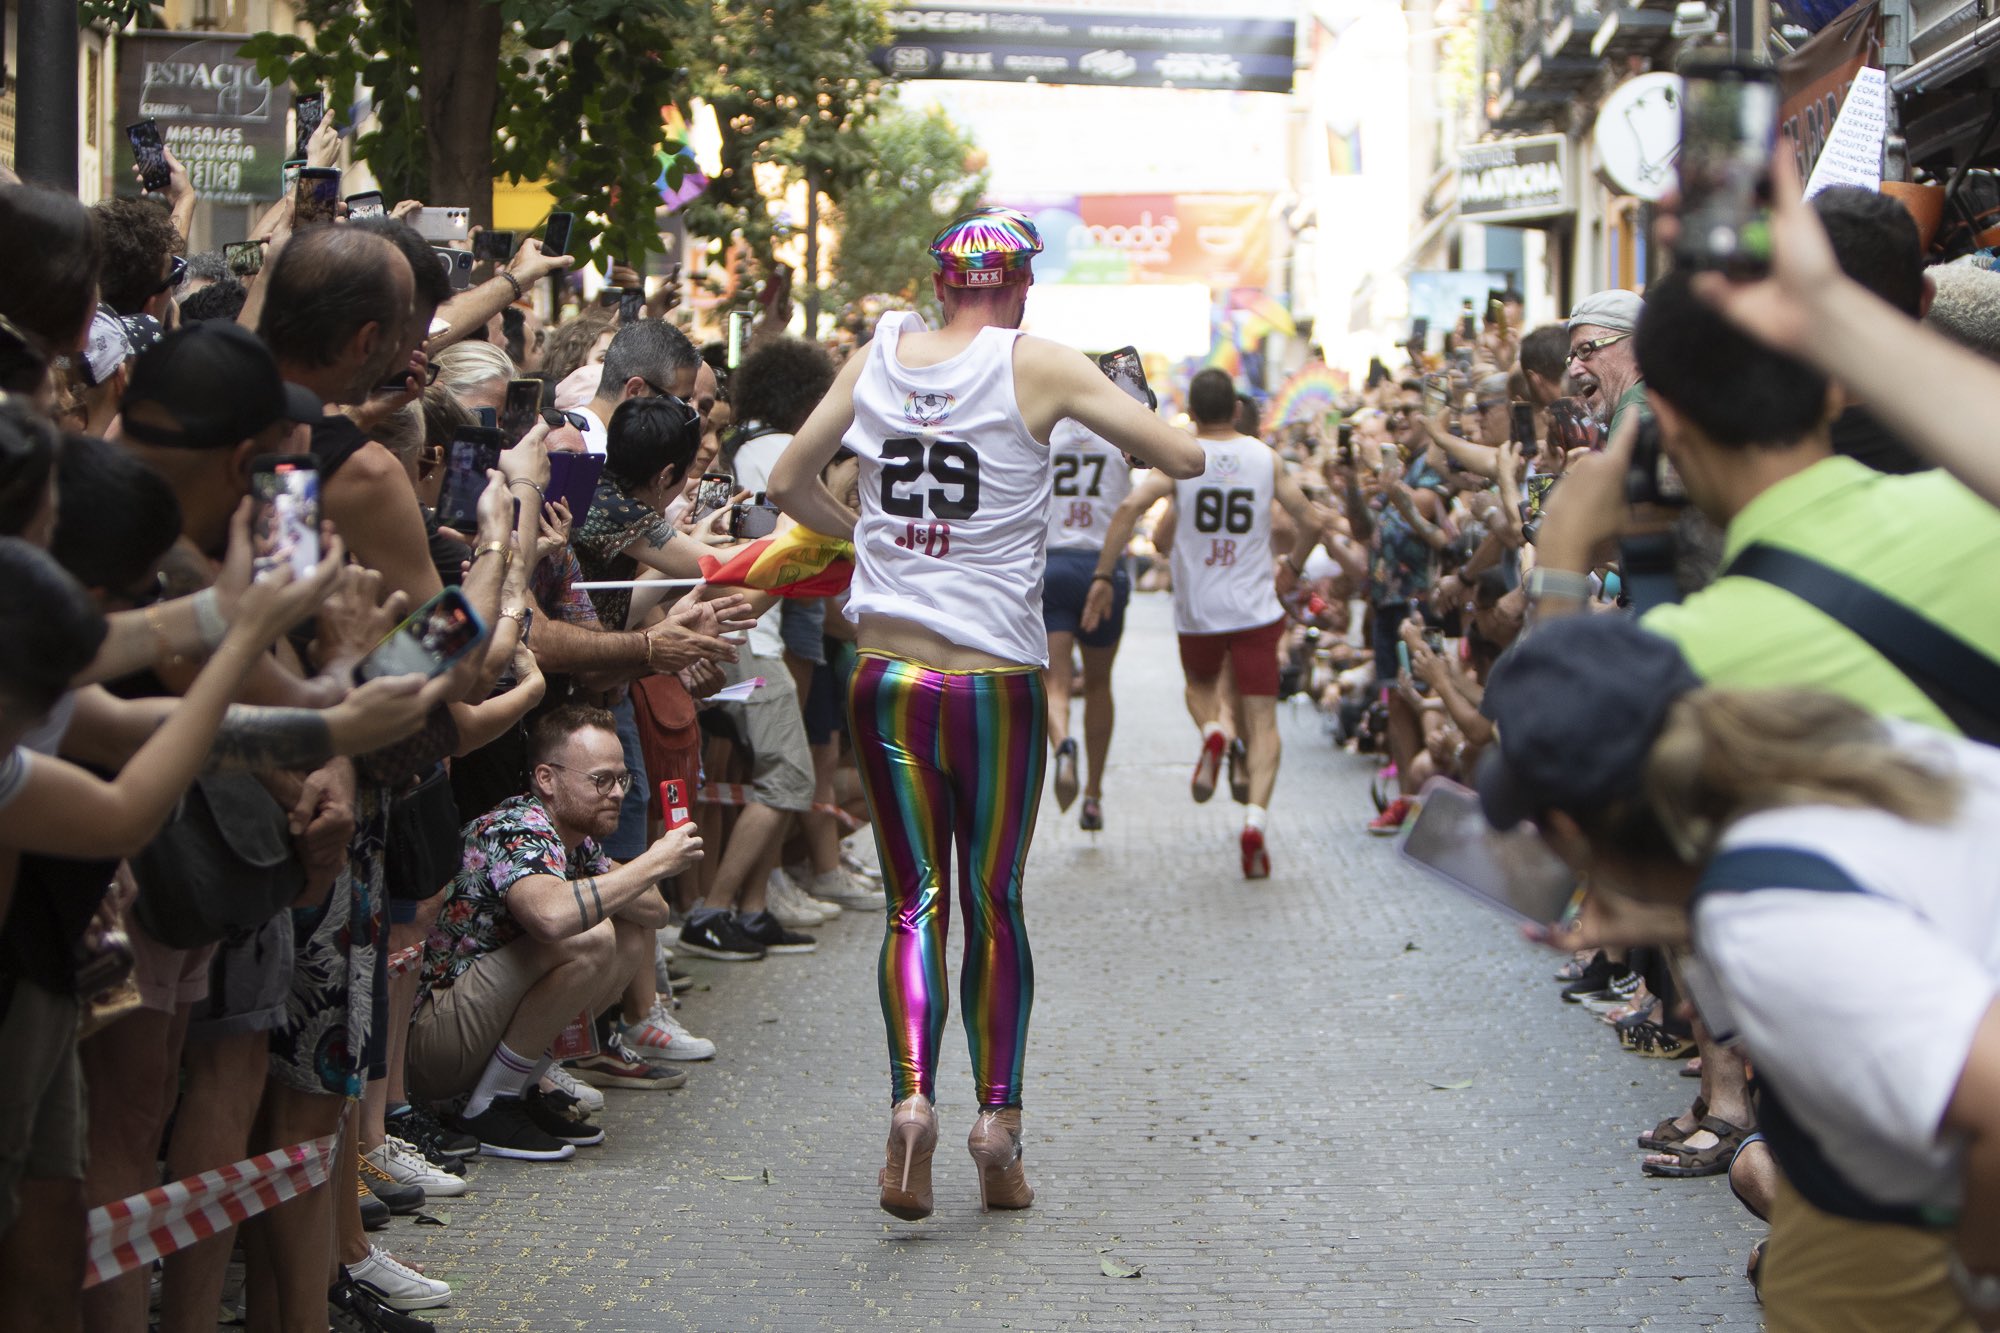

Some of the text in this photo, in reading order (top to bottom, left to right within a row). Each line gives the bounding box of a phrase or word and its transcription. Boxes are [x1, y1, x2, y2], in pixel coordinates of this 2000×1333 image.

[166, 125, 244, 143] MASAJES
[969, 271, 999, 281] XXX
[878, 437, 980, 521] 29
[1053, 453, 1108, 497] 27
[1194, 486, 1256, 535] 06
